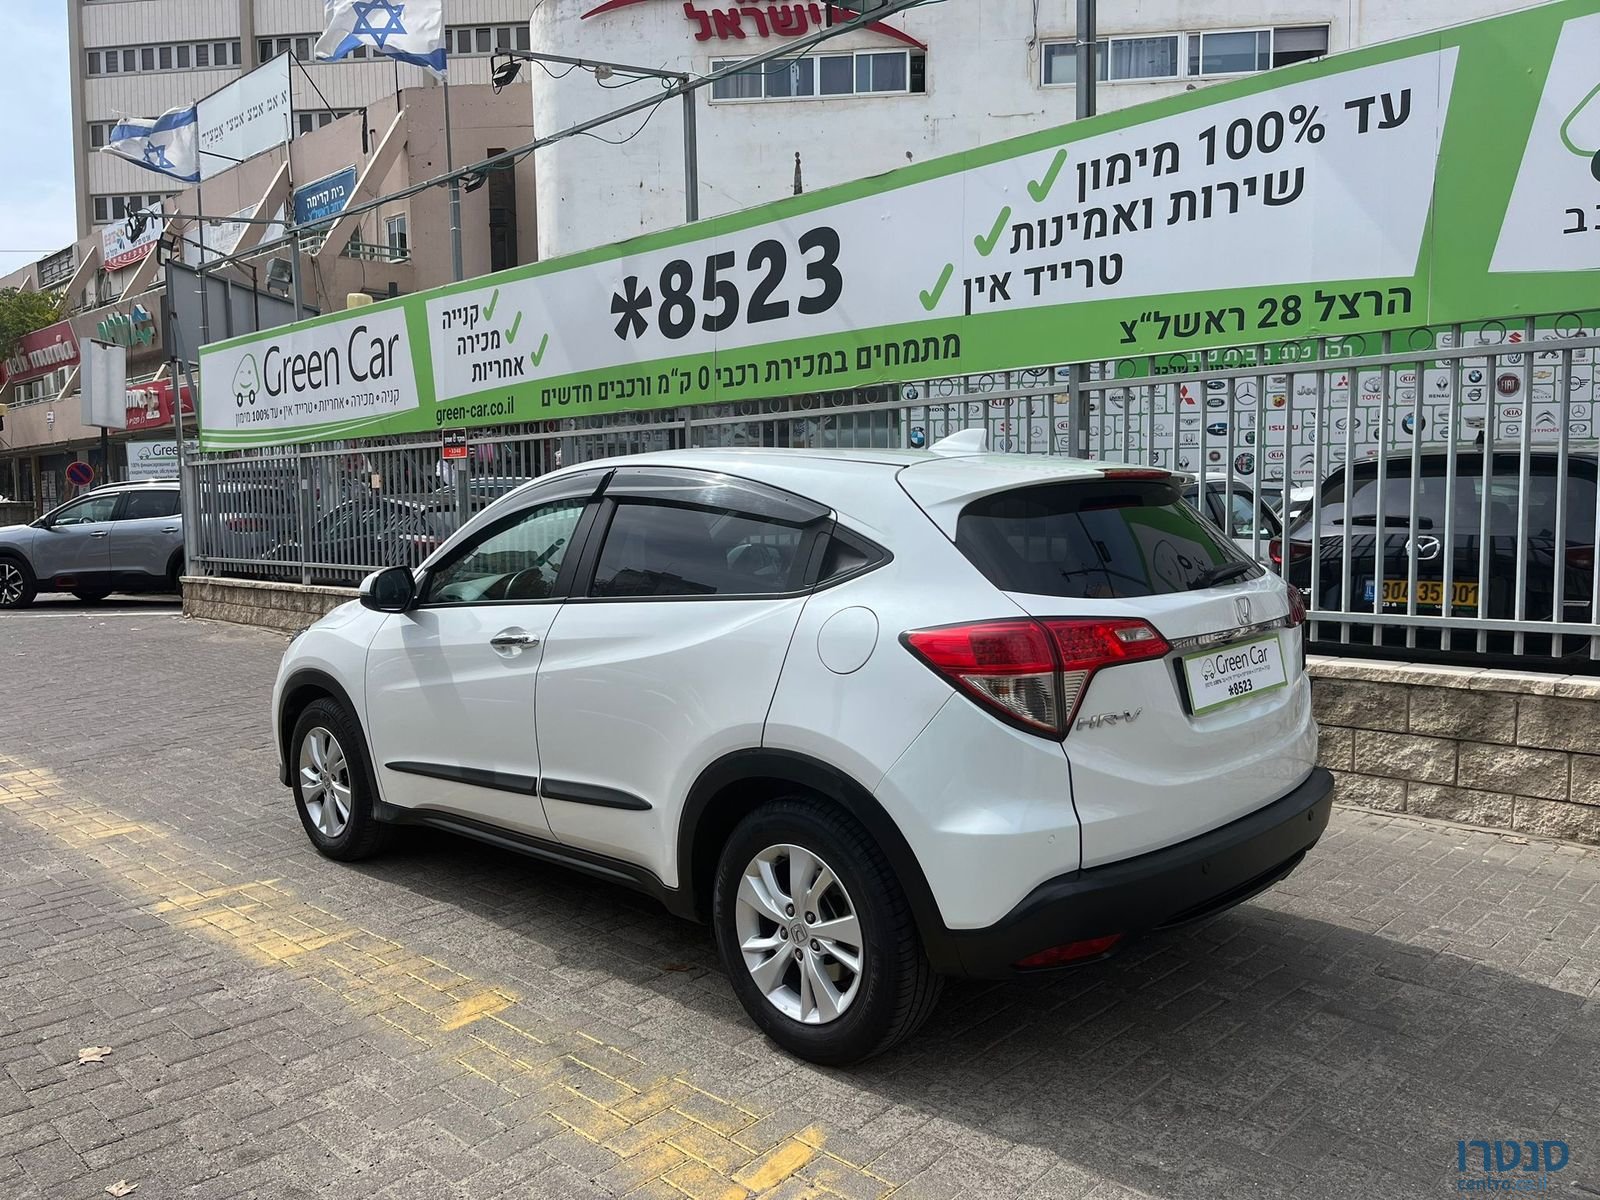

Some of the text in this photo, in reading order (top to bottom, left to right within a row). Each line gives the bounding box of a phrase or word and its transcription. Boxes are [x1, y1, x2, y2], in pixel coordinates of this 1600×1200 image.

[683, 3, 822, 41] ישראל
[1077, 89, 1411, 203] עד 100% מימון
[306, 185, 345, 209] בית קדימה
[1010, 167, 1304, 254] שירות ואמינות
[964, 254, 1122, 316] טרייד אין
[442, 304, 479, 330] קנייה
[1258, 295, 1301, 328] 28
[1315, 287, 1411, 321] הרצל
[457, 330, 500, 355] מכירה
[857, 334, 960, 370] מתמחים
[264, 326, 399, 397] Green Car
[472, 356, 524, 382] אחריות
[765, 351, 847, 383] במכירת
[599, 377, 651, 401] ורכבים
[699, 365, 709, 390] 0
[715, 364, 758, 388] רכבי
[1501, 379, 1515, 389] FIAT
[235, 389, 399, 427] קניה מכירה אחריות טרייד אין עד 100% מימון
[542, 384, 593, 407] חדשים
[436, 396, 514, 425] green-car.co.il
[152, 444, 178, 456] Gree
[1216, 646, 1267, 674] Green Car
[1076, 706, 1142, 731] HR-V
